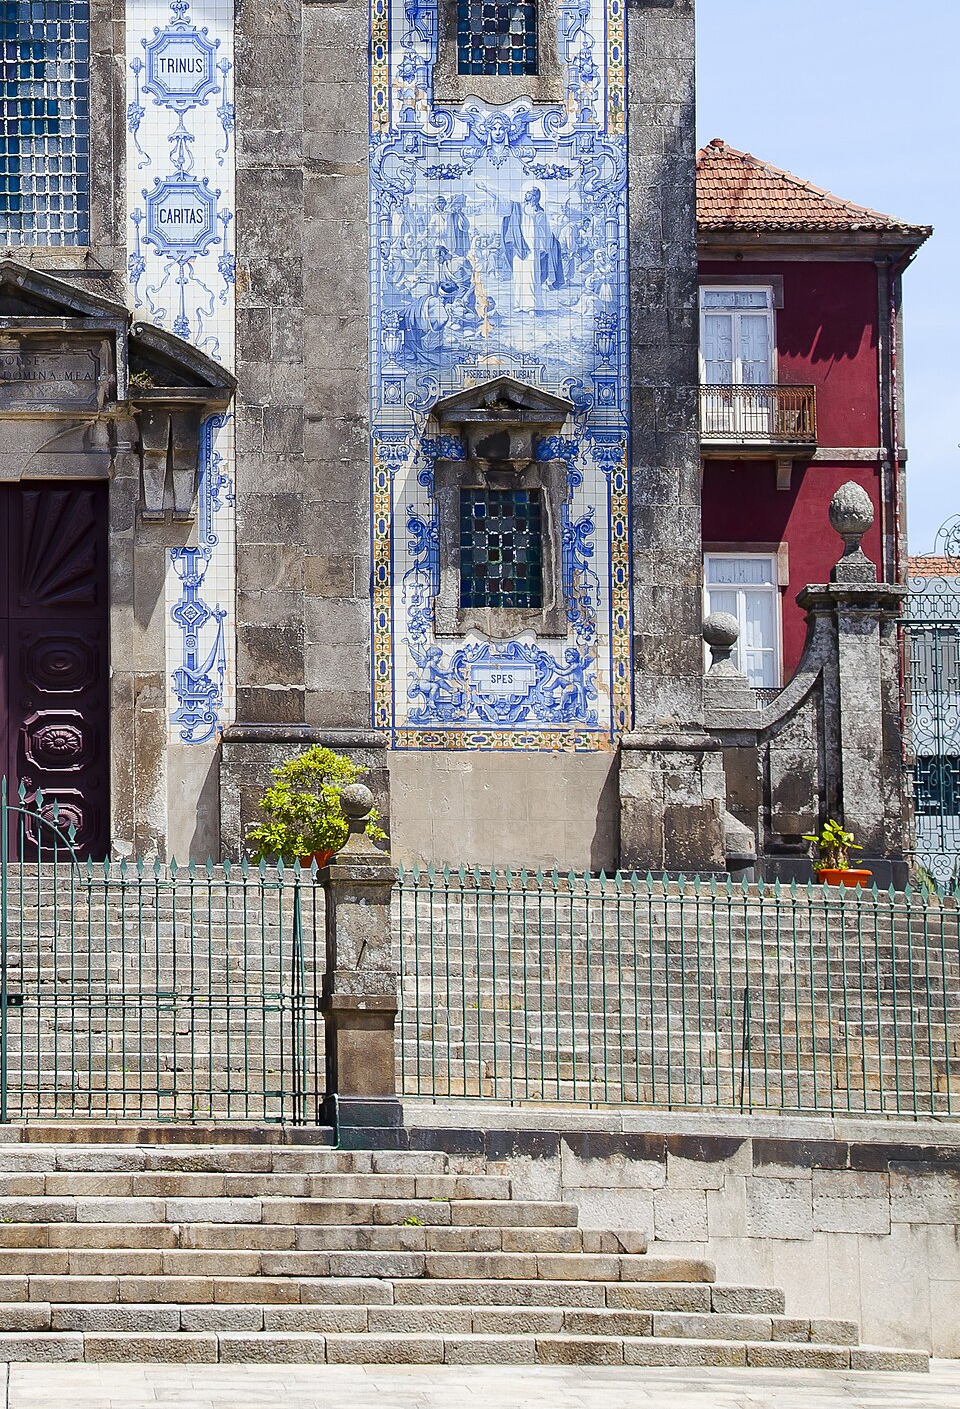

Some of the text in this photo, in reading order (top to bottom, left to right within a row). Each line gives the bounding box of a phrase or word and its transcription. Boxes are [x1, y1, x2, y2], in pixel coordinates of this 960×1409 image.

[159, 58, 203, 73] TRINUS
[159, 208, 204, 224] CARITAS
[3, 371, 56, 381] DOMINA
[64, 371, 92, 381] MEA
[490, 674, 513, 684] SPES
